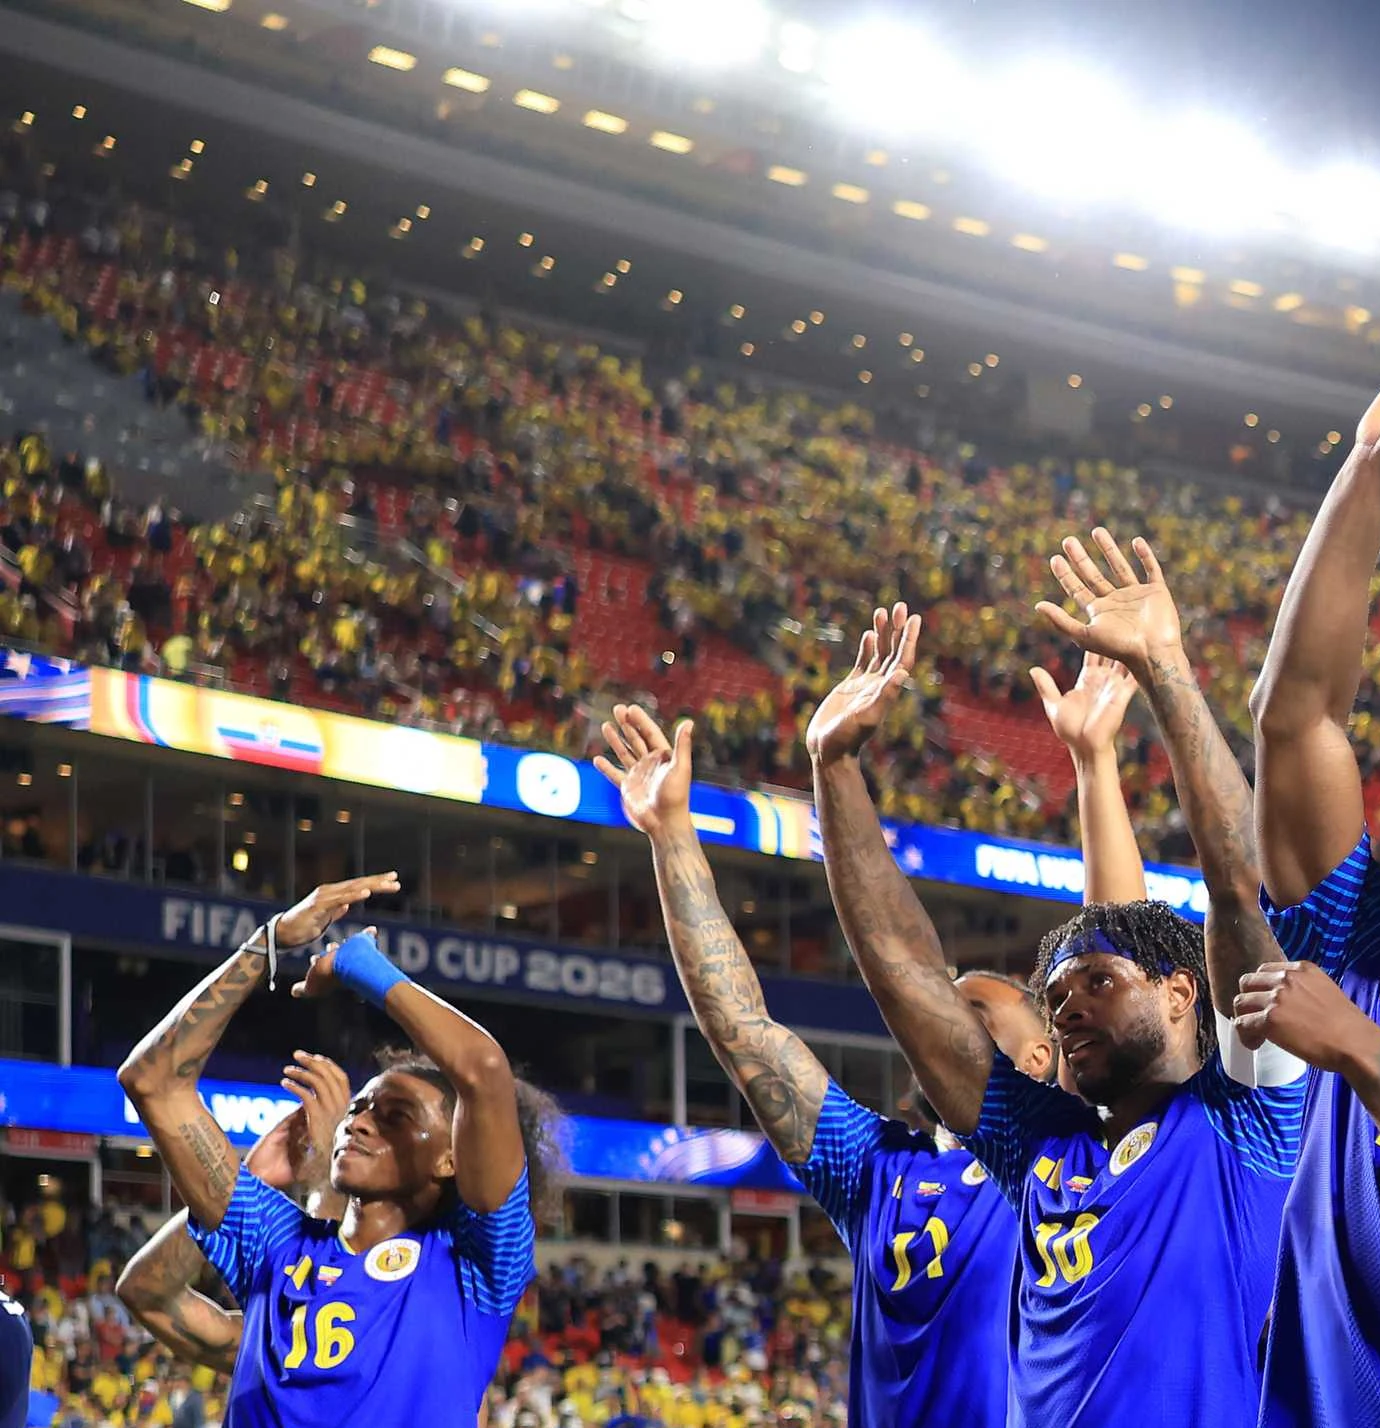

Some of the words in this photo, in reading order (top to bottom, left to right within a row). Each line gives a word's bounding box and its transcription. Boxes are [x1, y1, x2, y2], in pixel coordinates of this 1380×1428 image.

[162, 899, 258, 950] FIFA
[436, 937, 520, 985] CUP
[524, 949, 666, 1005] 2026
[1035, 1212, 1099, 1287] 10
[283, 1301, 356, 1369] 16
